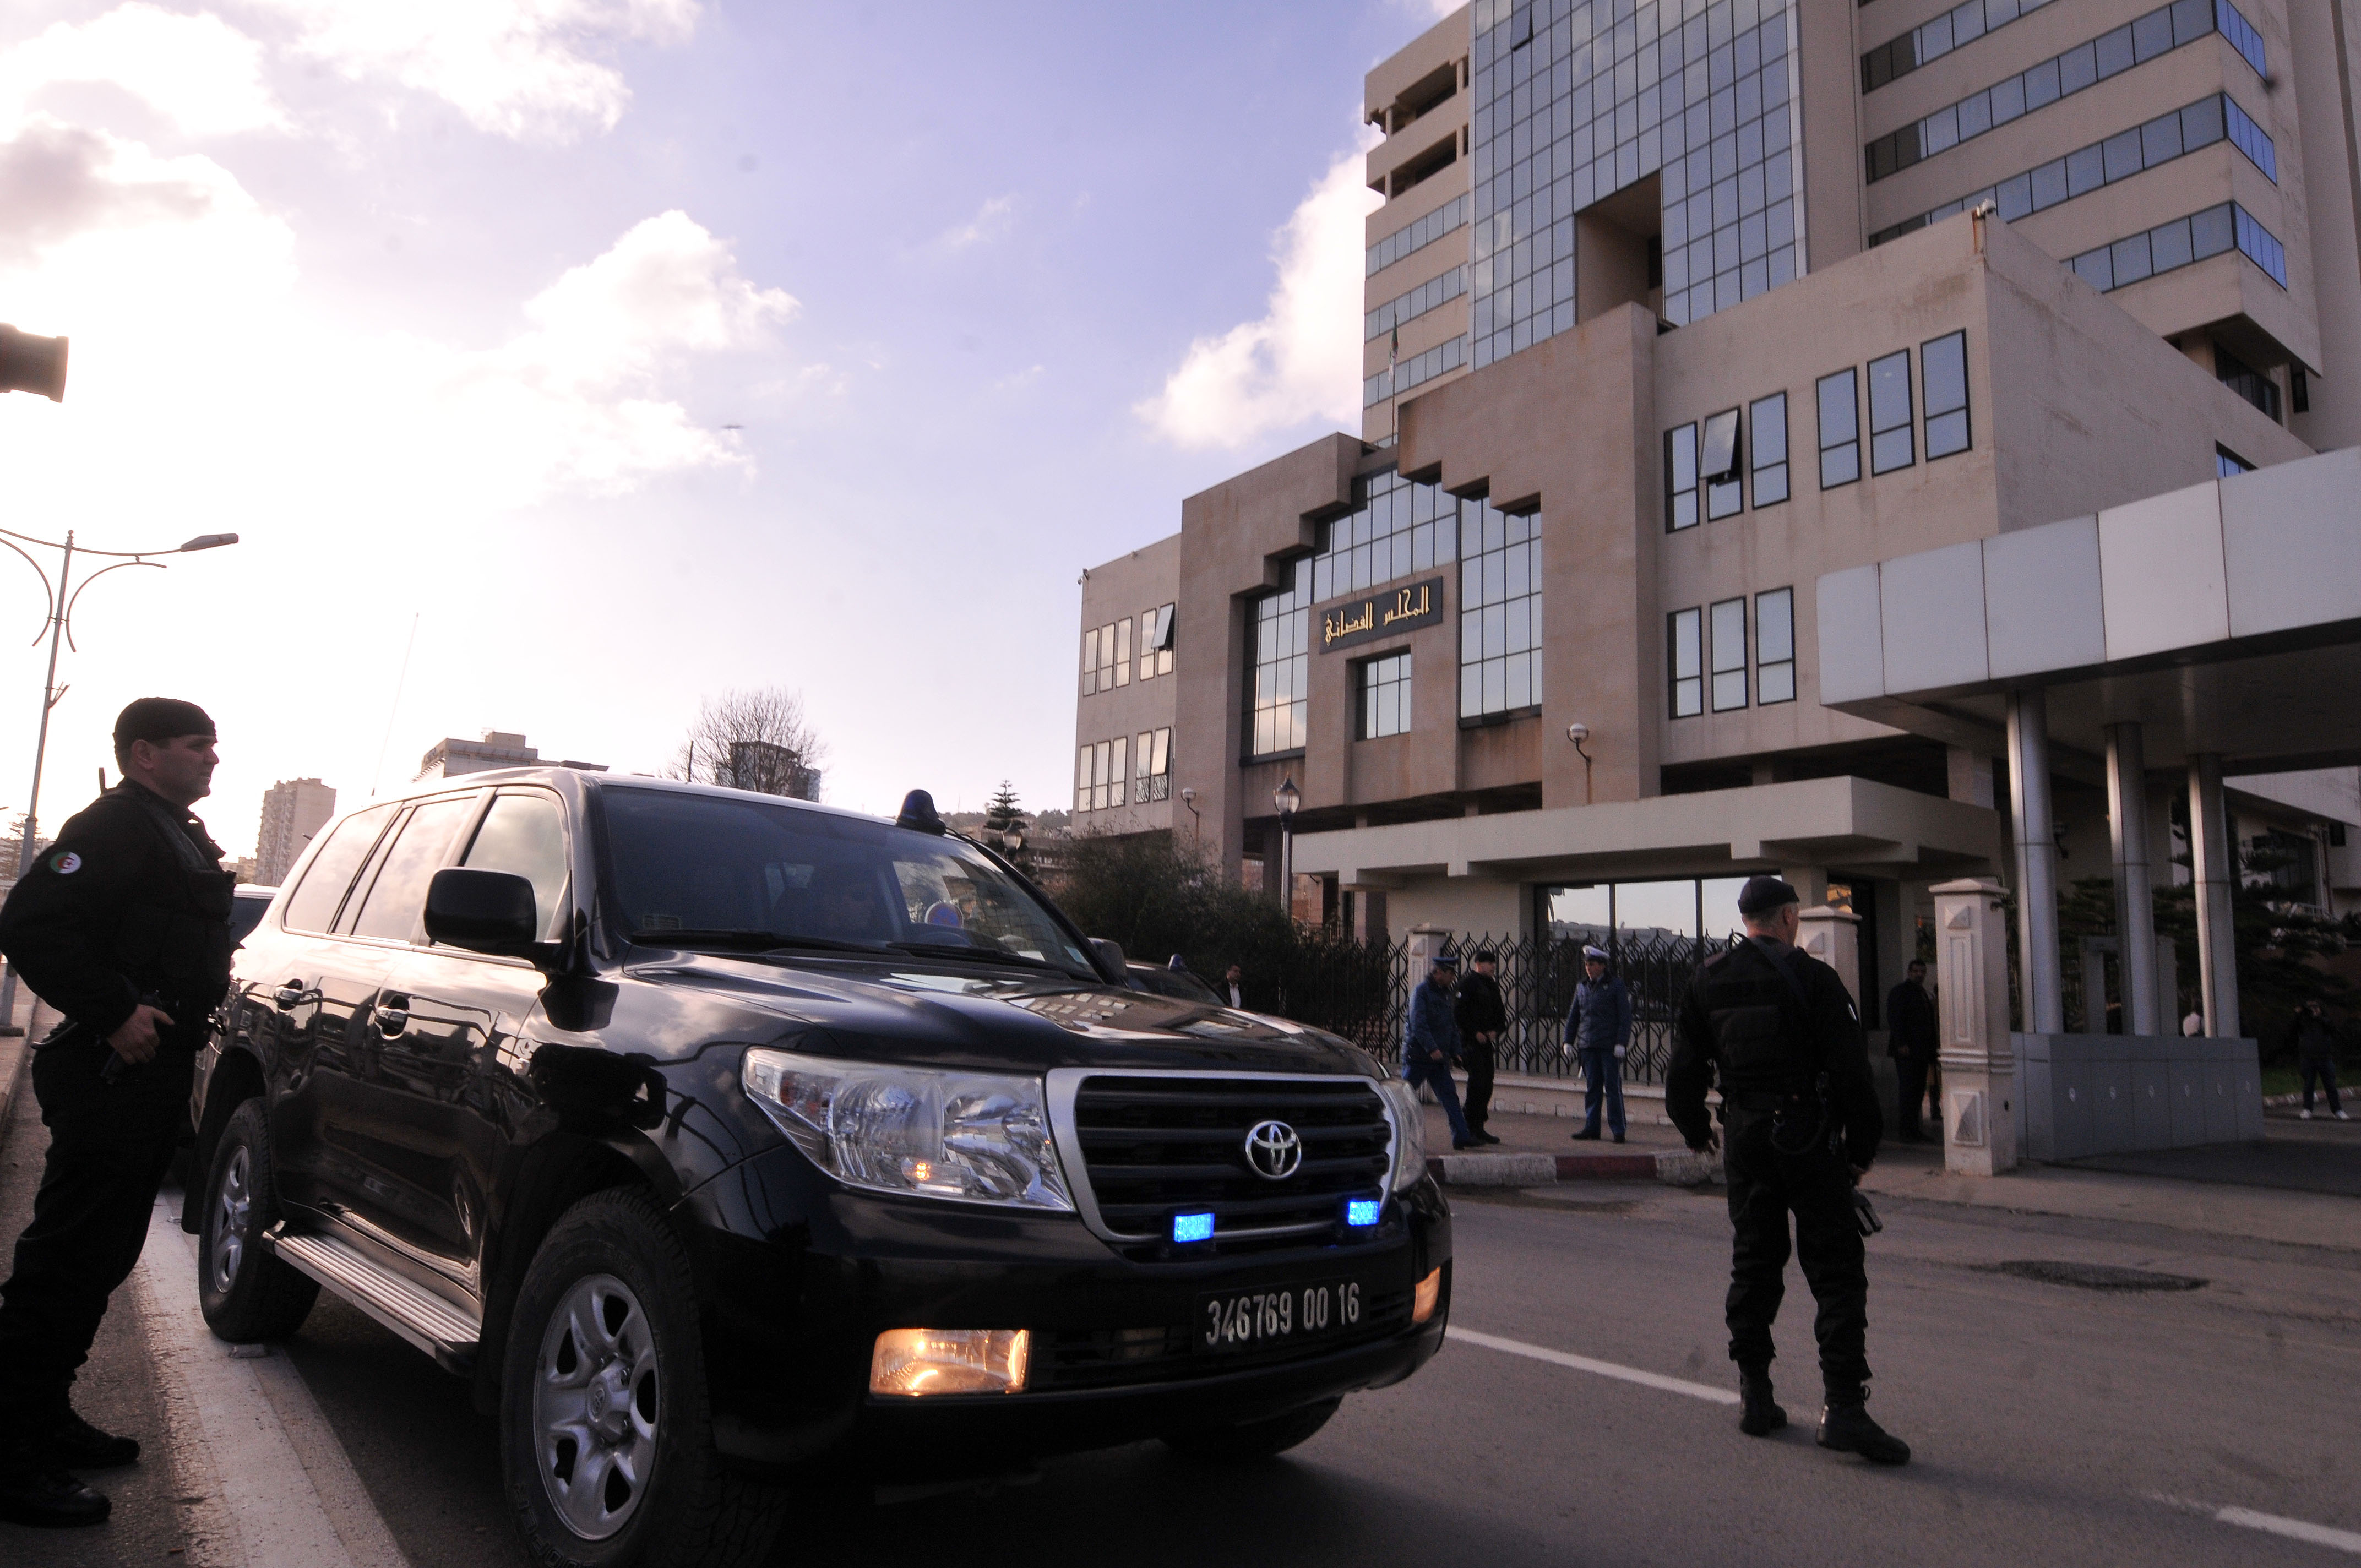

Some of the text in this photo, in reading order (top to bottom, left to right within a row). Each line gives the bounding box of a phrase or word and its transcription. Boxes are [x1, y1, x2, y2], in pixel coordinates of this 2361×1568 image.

[1383, 585, 1430, 627] المجلس
[1206, 1282, 1359, 1345] 346769 00 16
